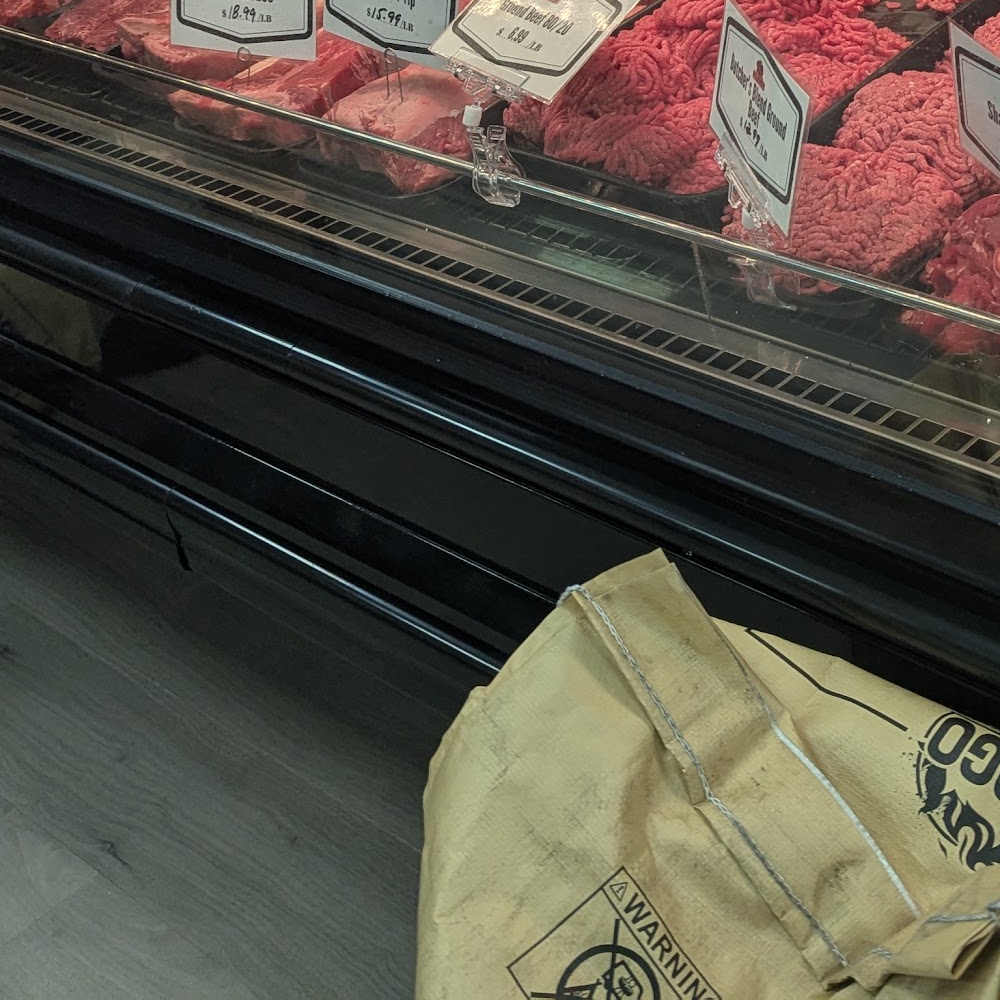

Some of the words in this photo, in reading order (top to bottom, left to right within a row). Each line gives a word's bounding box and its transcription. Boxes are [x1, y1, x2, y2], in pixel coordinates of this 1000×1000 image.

[507, 26, 530, 44] 6.99
[524, 6, 550, 26] Beef
[542, 14, 574, 36] 80/20
[747, 99, 761, 129] Beef
[752, 82, 768, 117] Blend
[766, 102, 788, 142] Ground
[623, 891, 715, 1000] WARNIN
